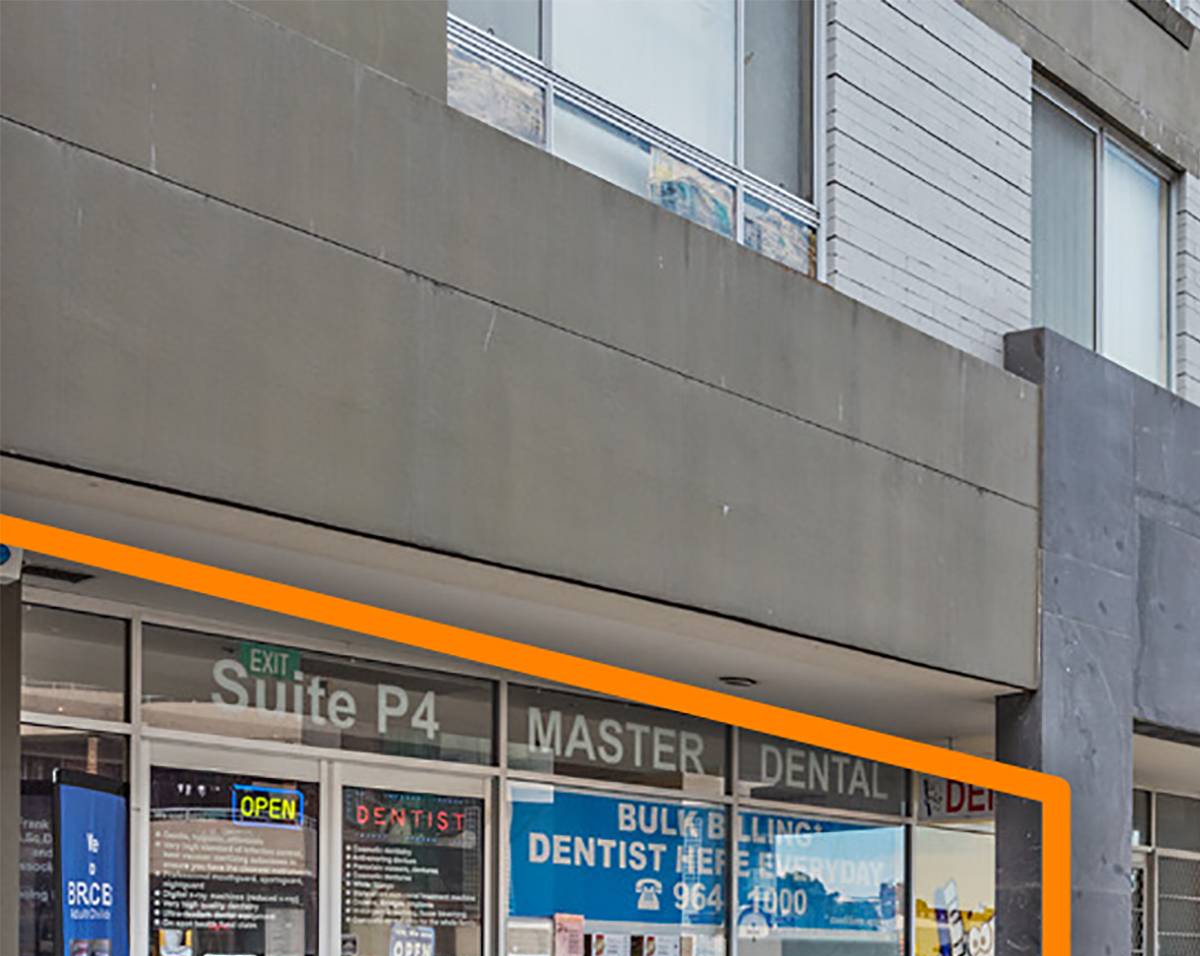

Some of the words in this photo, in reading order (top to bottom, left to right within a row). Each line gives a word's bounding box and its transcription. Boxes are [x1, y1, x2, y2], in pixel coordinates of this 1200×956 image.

[251, 649, 290, 675] EXIT
[211, 659, 358, 729] Suite
[377, 683, 440, 739] P4
[528, 707, 705, 775] MASTER
[761, 744, 889, 800] DENTAL
[240, 796, 296, 820] OPEN
[356, 804, 465, 831] DENTIST
[618, 803, 699, 838] BULK
[528, 832, 667, 872] DENTIST
[759, 851, 884, 887] EVERYDAY
[747, 887, 808, 916] 1000
